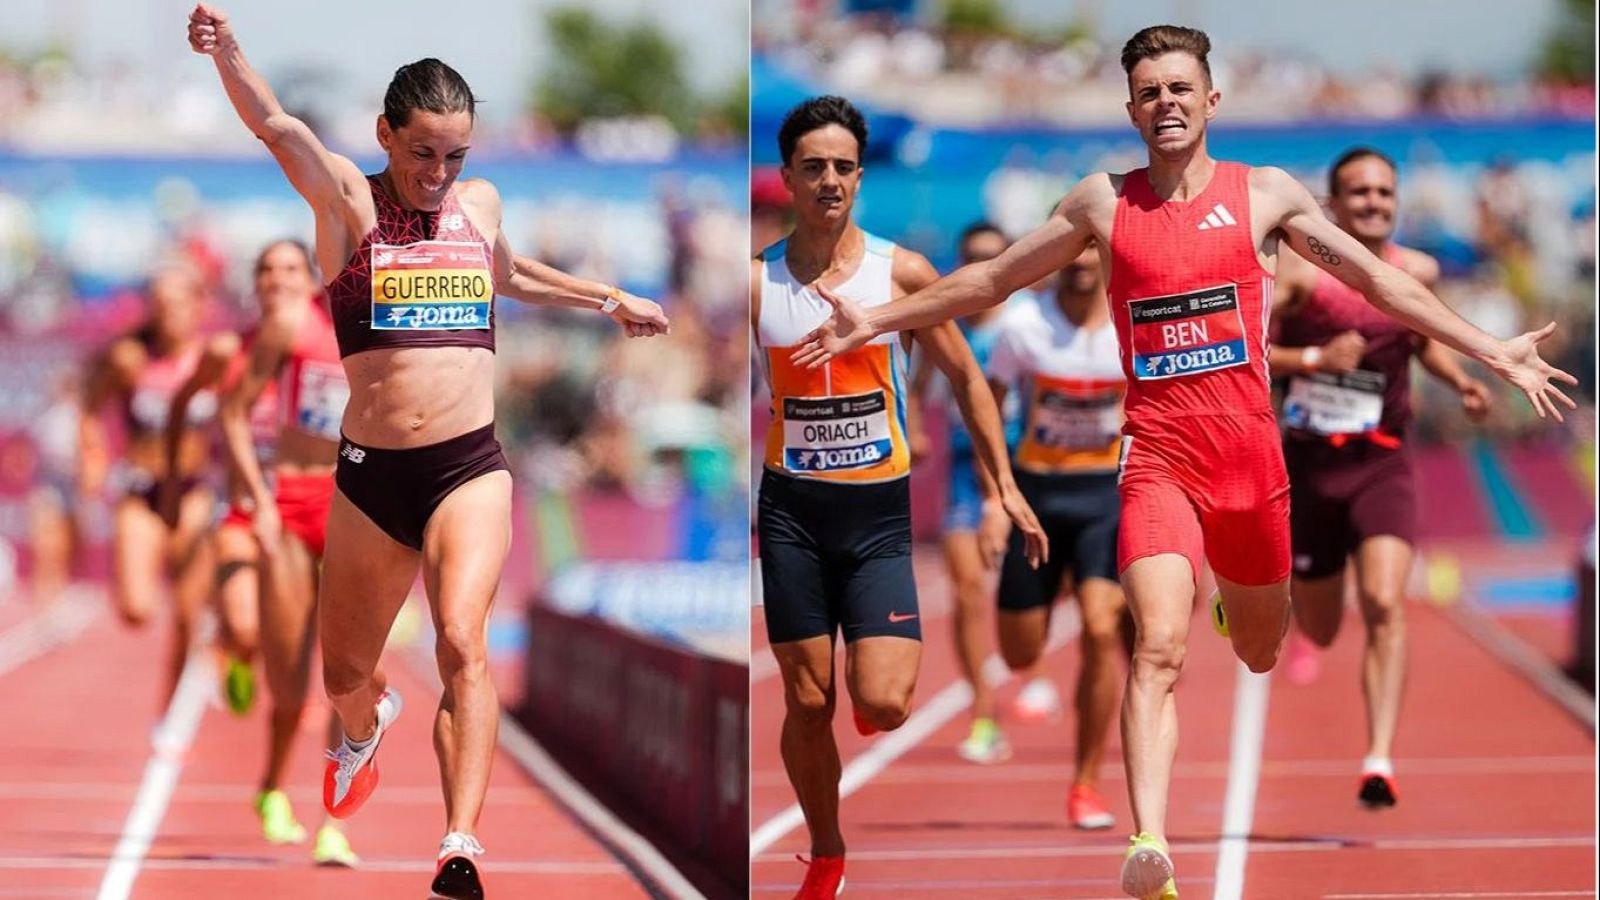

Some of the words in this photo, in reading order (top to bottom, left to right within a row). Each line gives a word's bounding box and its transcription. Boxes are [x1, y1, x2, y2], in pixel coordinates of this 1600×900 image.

[383, 276, 485, 299] GUERRERO
[410, 307, 478, 328] Joma
[1162, 320, 1208, 348] BEN
[1165, 345, 1235, 374] Joma
[803, 421, 868, 443] ORIACH
[815, 445, 881, 469] Joma
